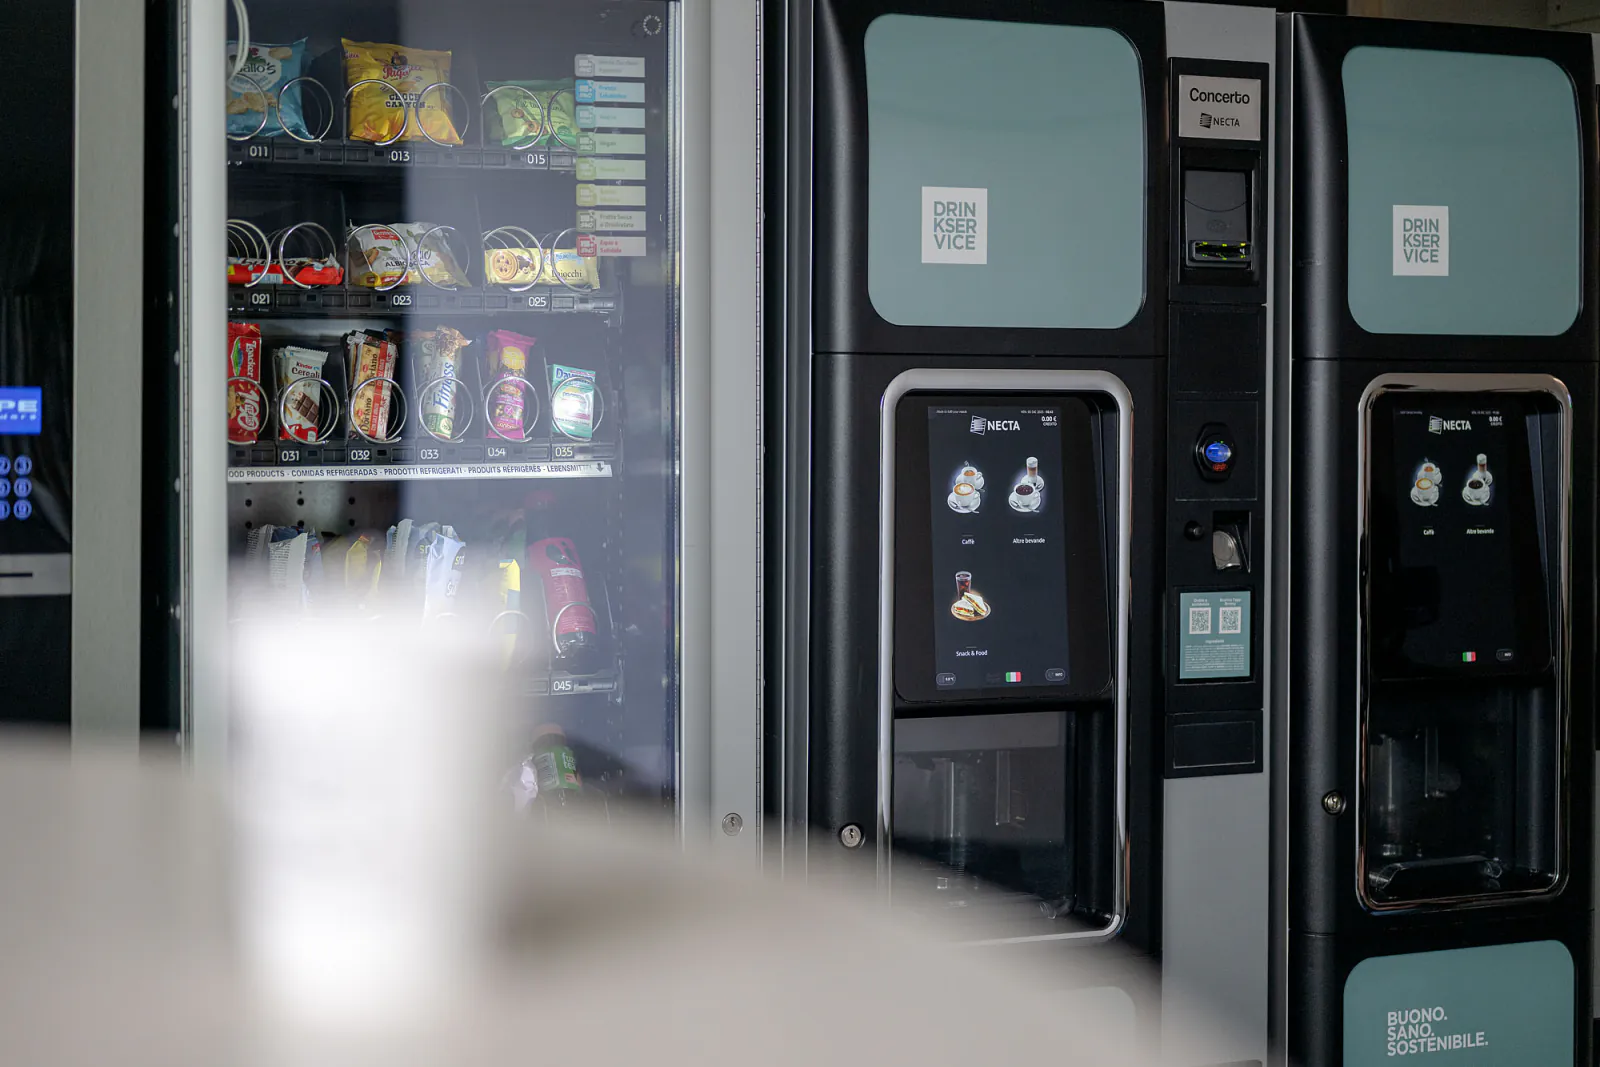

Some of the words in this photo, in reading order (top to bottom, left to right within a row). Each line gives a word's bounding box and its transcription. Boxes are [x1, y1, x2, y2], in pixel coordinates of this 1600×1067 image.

[1189, 87, 1250, 104] Concerto
[1213, 117, 1240, 127] NECTA
[249, 146, 268, 157] 011
[391, 151, 410, 161] 013
[527, 154, 546, 165] 015
[933, 200, 976, 217] DRIN
[933, 217, 977, 234] KSER
[1403, 218, 1440, 233] DRIN
[933, 233, 976, 251] VICE
[1403, 233, 1441, 248] KSER
[1403, 248, 1440, 263] VICE
[252, 294, 270, 304] 021
[393, 295, 412, 305] 023
[528, 297, 547, 307] 025
[245, 341, 257, 378] Loacker
[291, 366, 321, 379] Cereali
[433, 362, 455, 409] Fitness
[360, 397, 372, 433] Doriano
[987, 420, 1021, 431] NECTA
[1443, 420, 1472, 431] NECTA
[281, 450, 300, 461] 031
[350, 449, 370, 461] 032
[420, 449, 439, 459] 033
[487, 447, 506, 457] 034
[555, 446, 573, 457] 035
[291, 469, 325, 477] COMIDAS
[326, 468, 378, 476] REFRIGERADAS
[384, 467, 419, 476] PRODOTTI
[420, 467, 463, 475] REFRIGERATI
[468, 466, 501, 474] PRODUITS
[553, 680, 571, 692] 045
[1387, 1006, 1448, 1027] BUONO.
[1387, 1023, 1435, 1042] SANO.
[1387, 1031, 1489, 1057] SOSTENIBILE.
